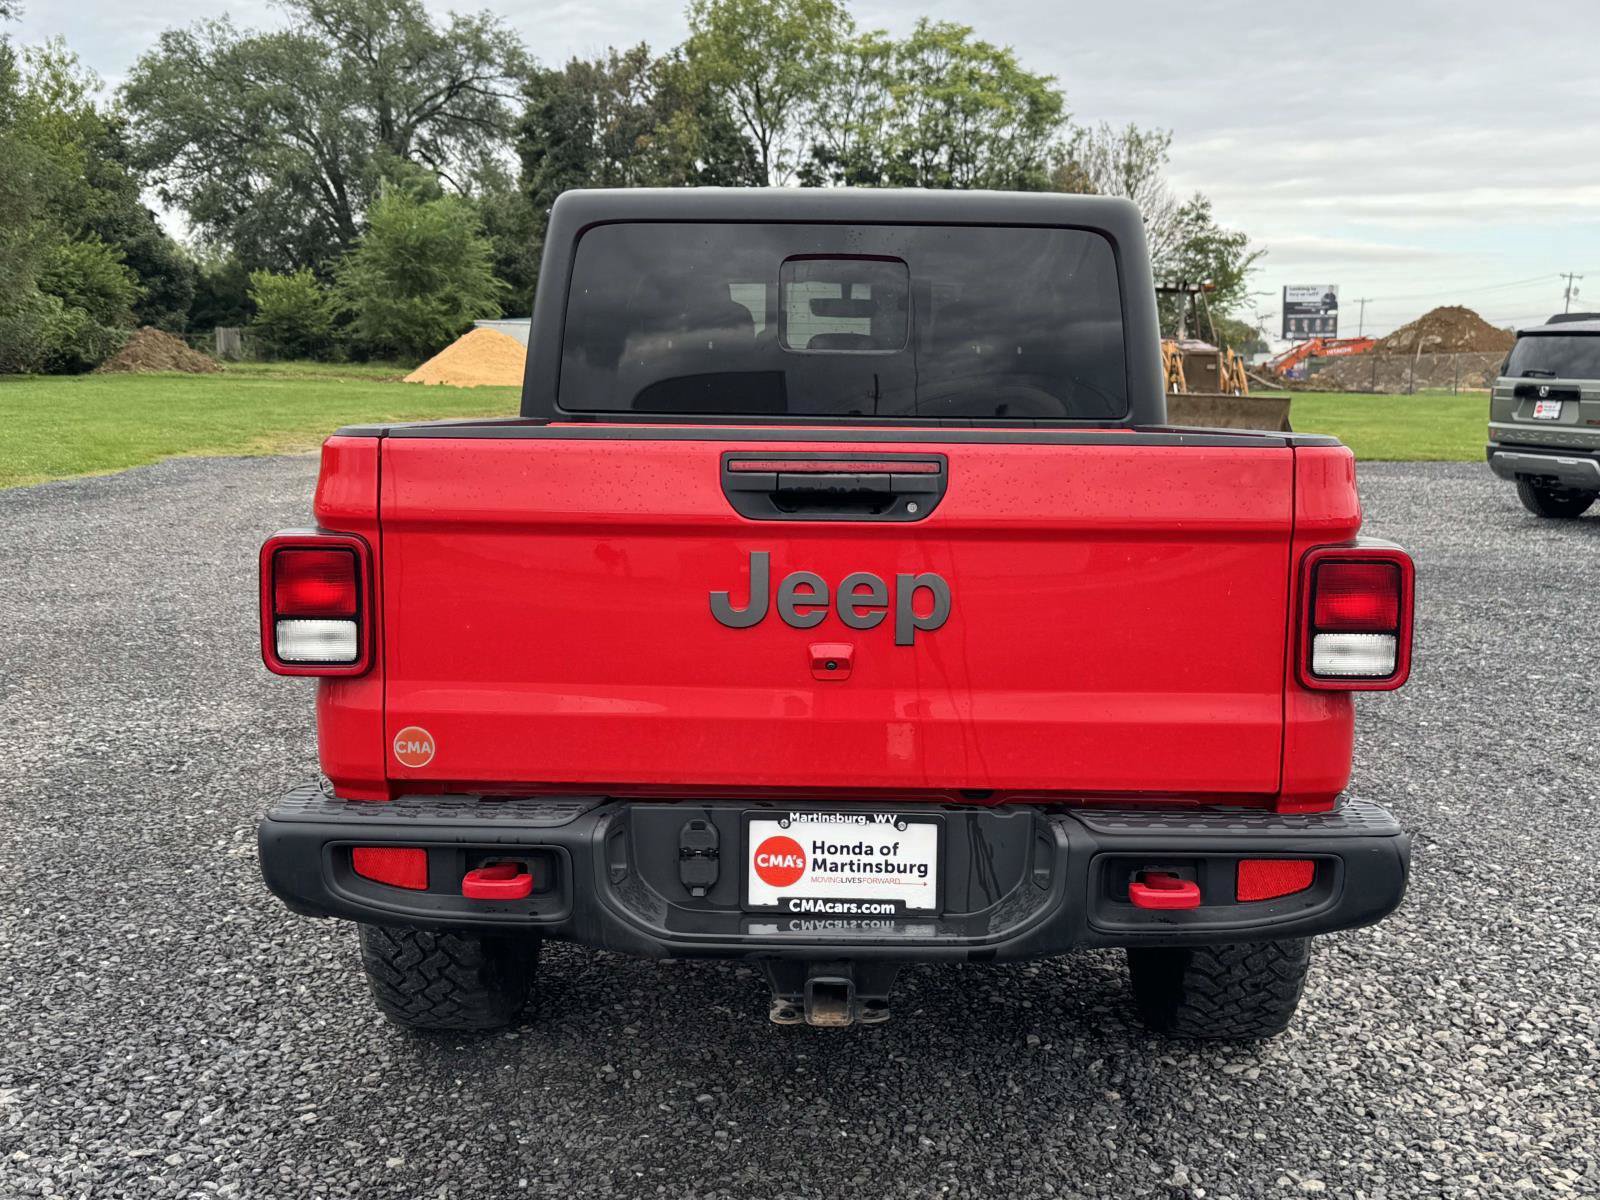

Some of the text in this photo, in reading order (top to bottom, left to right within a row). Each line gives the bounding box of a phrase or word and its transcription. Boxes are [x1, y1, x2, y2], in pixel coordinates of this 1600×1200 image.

[709, 550, 951, 646] Jeep
[395, 740, 431, 754] CMA
[789, 812, 897, 825] Martinsburg, WV
[812, 840, 900, 856] Honda of
[756, 854, 803, 868] CMA's
[811, 858, 928, 878] Martinsburg
[788, 899, 895, 914] CMAcars.com
